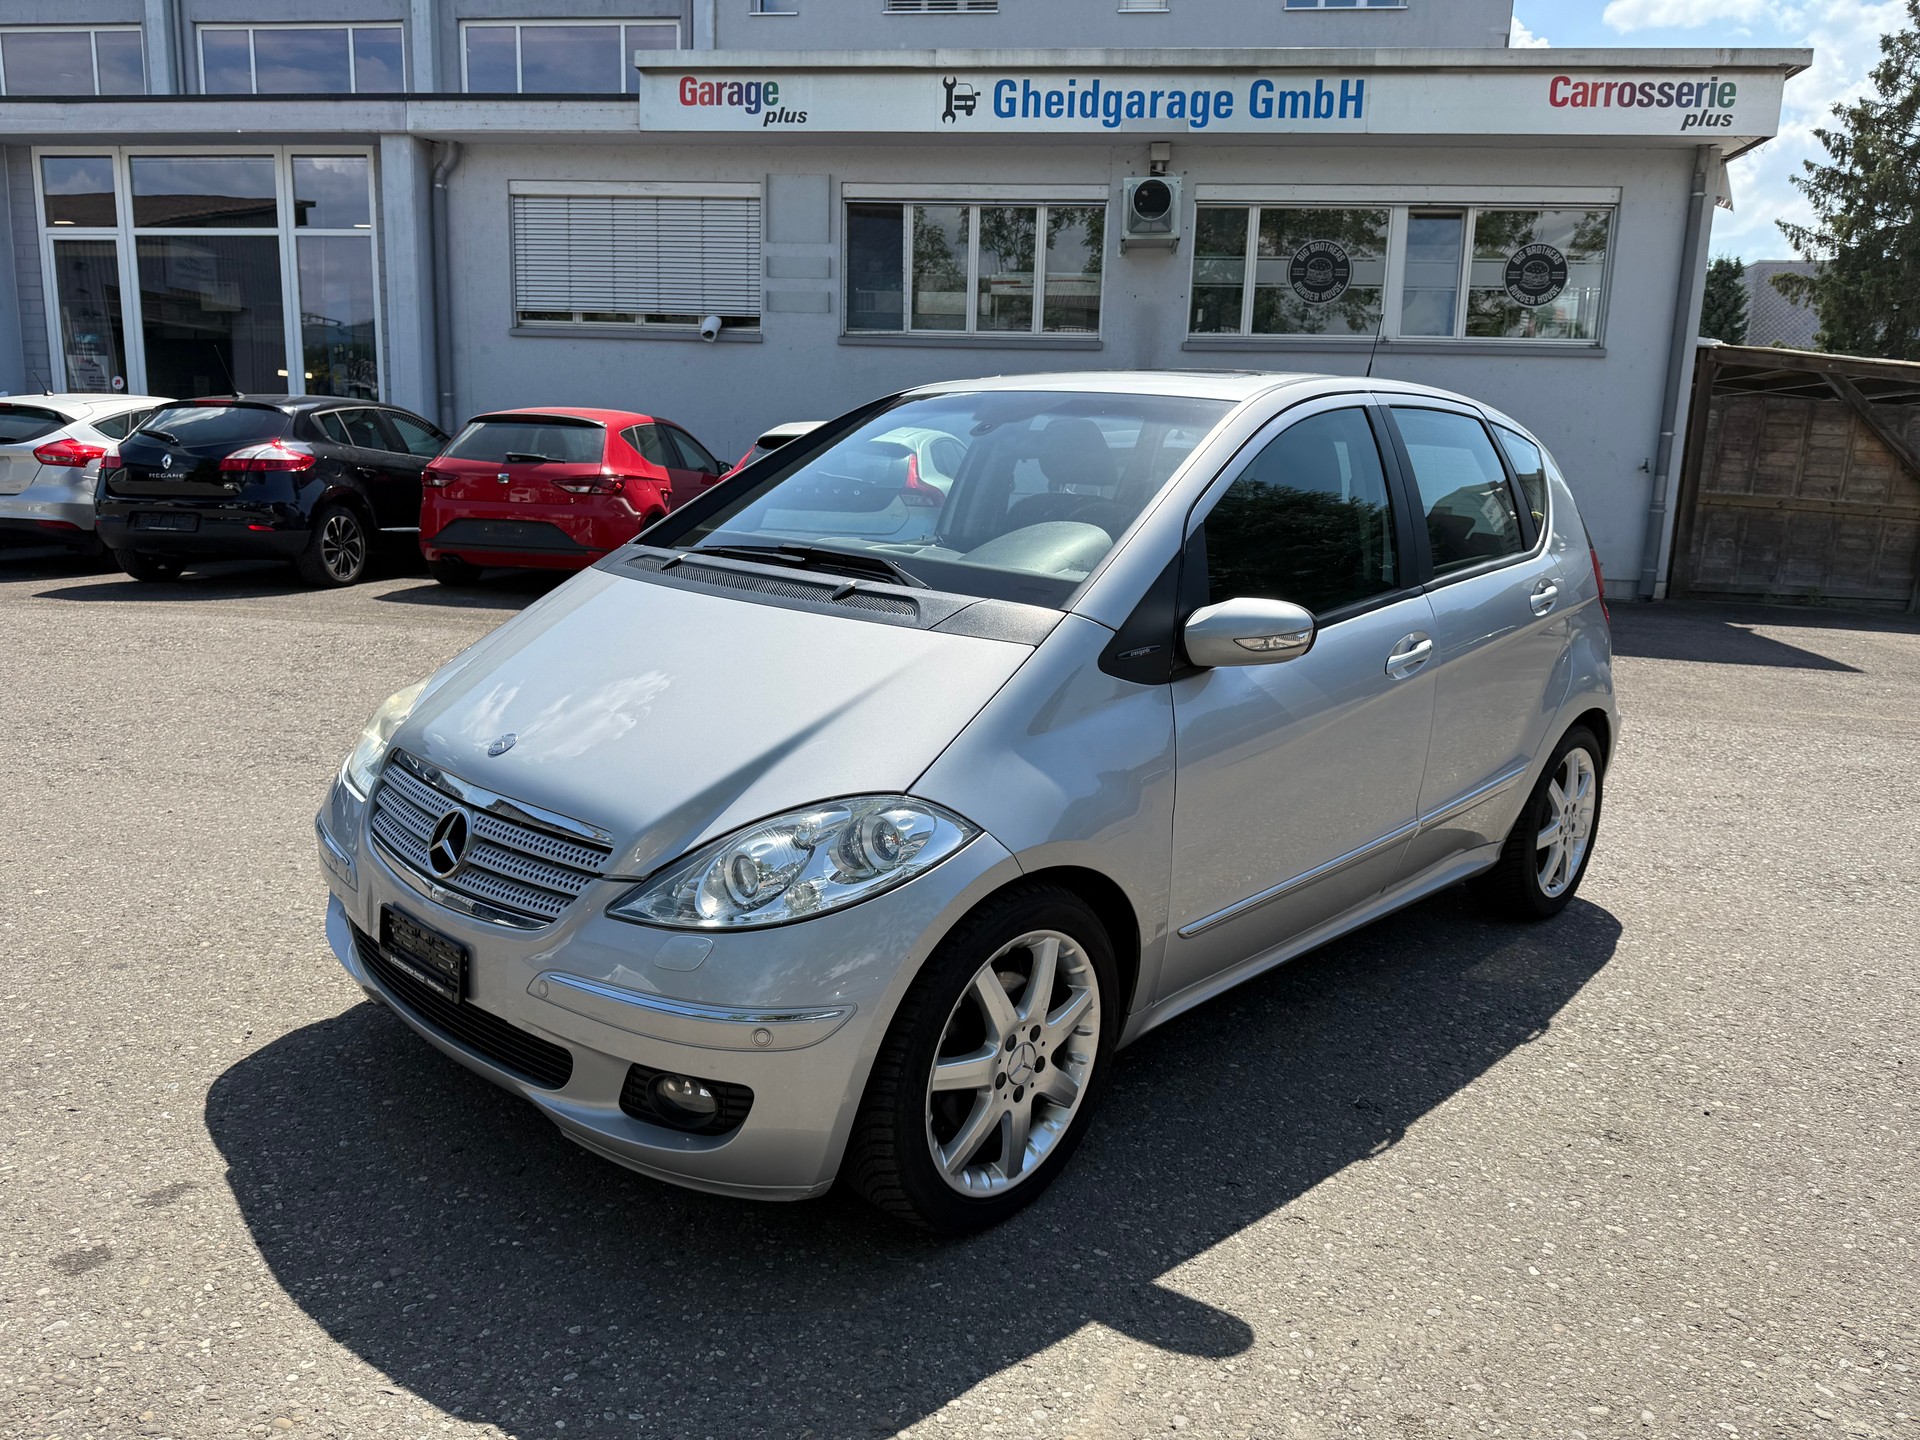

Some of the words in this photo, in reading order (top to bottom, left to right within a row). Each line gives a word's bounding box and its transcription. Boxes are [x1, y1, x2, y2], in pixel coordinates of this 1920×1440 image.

[679, 76, 779, 114] Garage
[1549, 76, 1737, 108] Carrosserie
[993, 79, 1234, 128] Gheidgarage
[1249, 79, 1365, 119] GmbH
[763, 107, 808, 127] plus
[1680, 109, 1734, 131] plus
[1296, 248, 1310, 262] BIG
[1309, 242, 1346, 262] BROTHERS
[1512, 251, 1526, 265] BIG
[1525, 245, 1563, 265] BROTHERS
[1293, 281, 1319, 301] BURGER
[1321, 281, 1344, 301] HOUSE
[1508, 284, 1535, 304] BURGER
[1537, 284, 1561, 304] HOUSE
